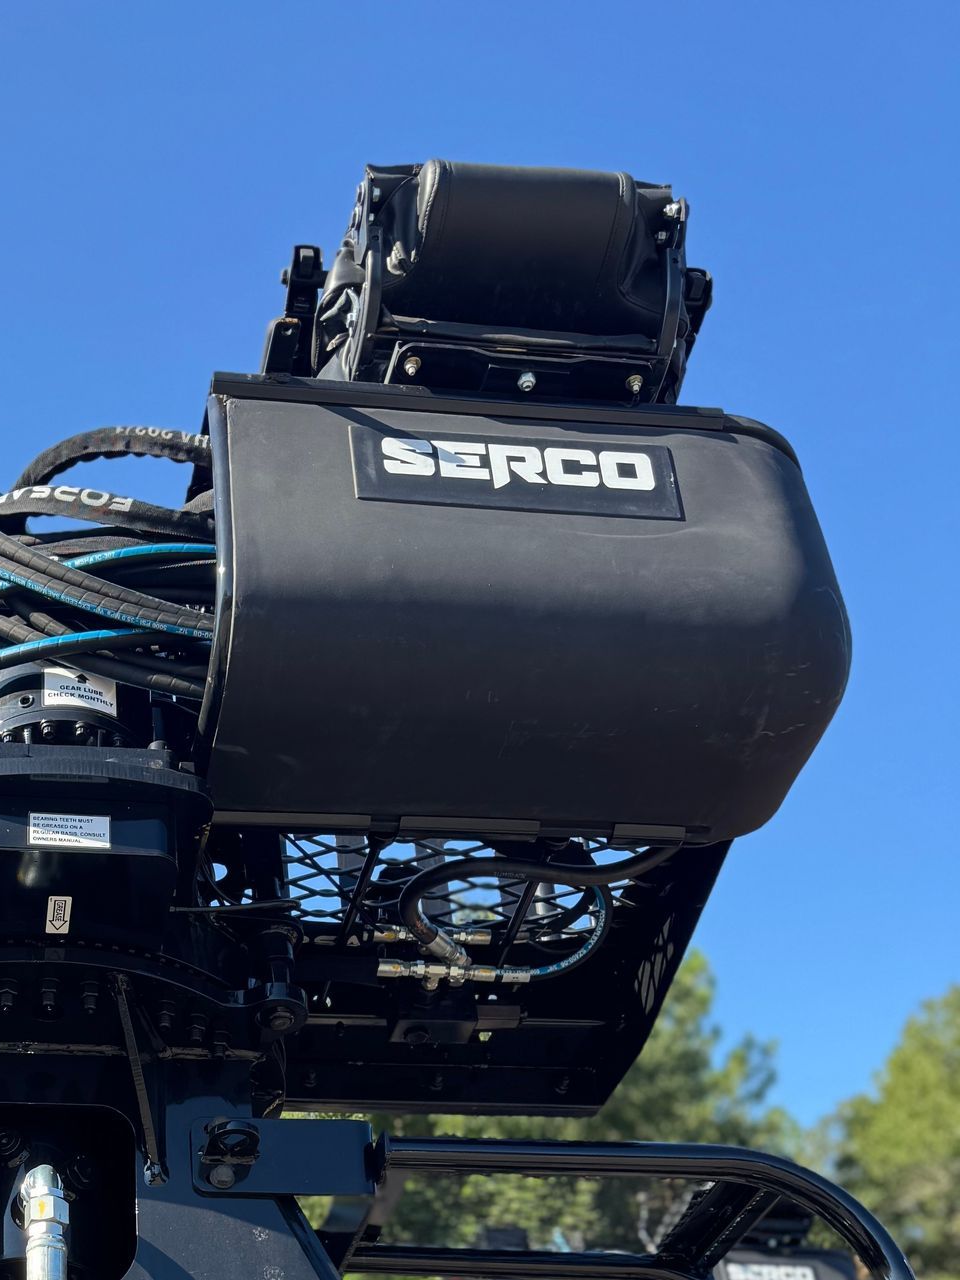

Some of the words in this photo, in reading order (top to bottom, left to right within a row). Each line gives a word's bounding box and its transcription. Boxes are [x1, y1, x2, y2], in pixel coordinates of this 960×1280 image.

[381, 436, 656, 491] SERCO
[77, 693, 114, 708] MONTHLY
[83, 687, 104, 697] LUBE
[55, 902, 64, 922] GREASE
